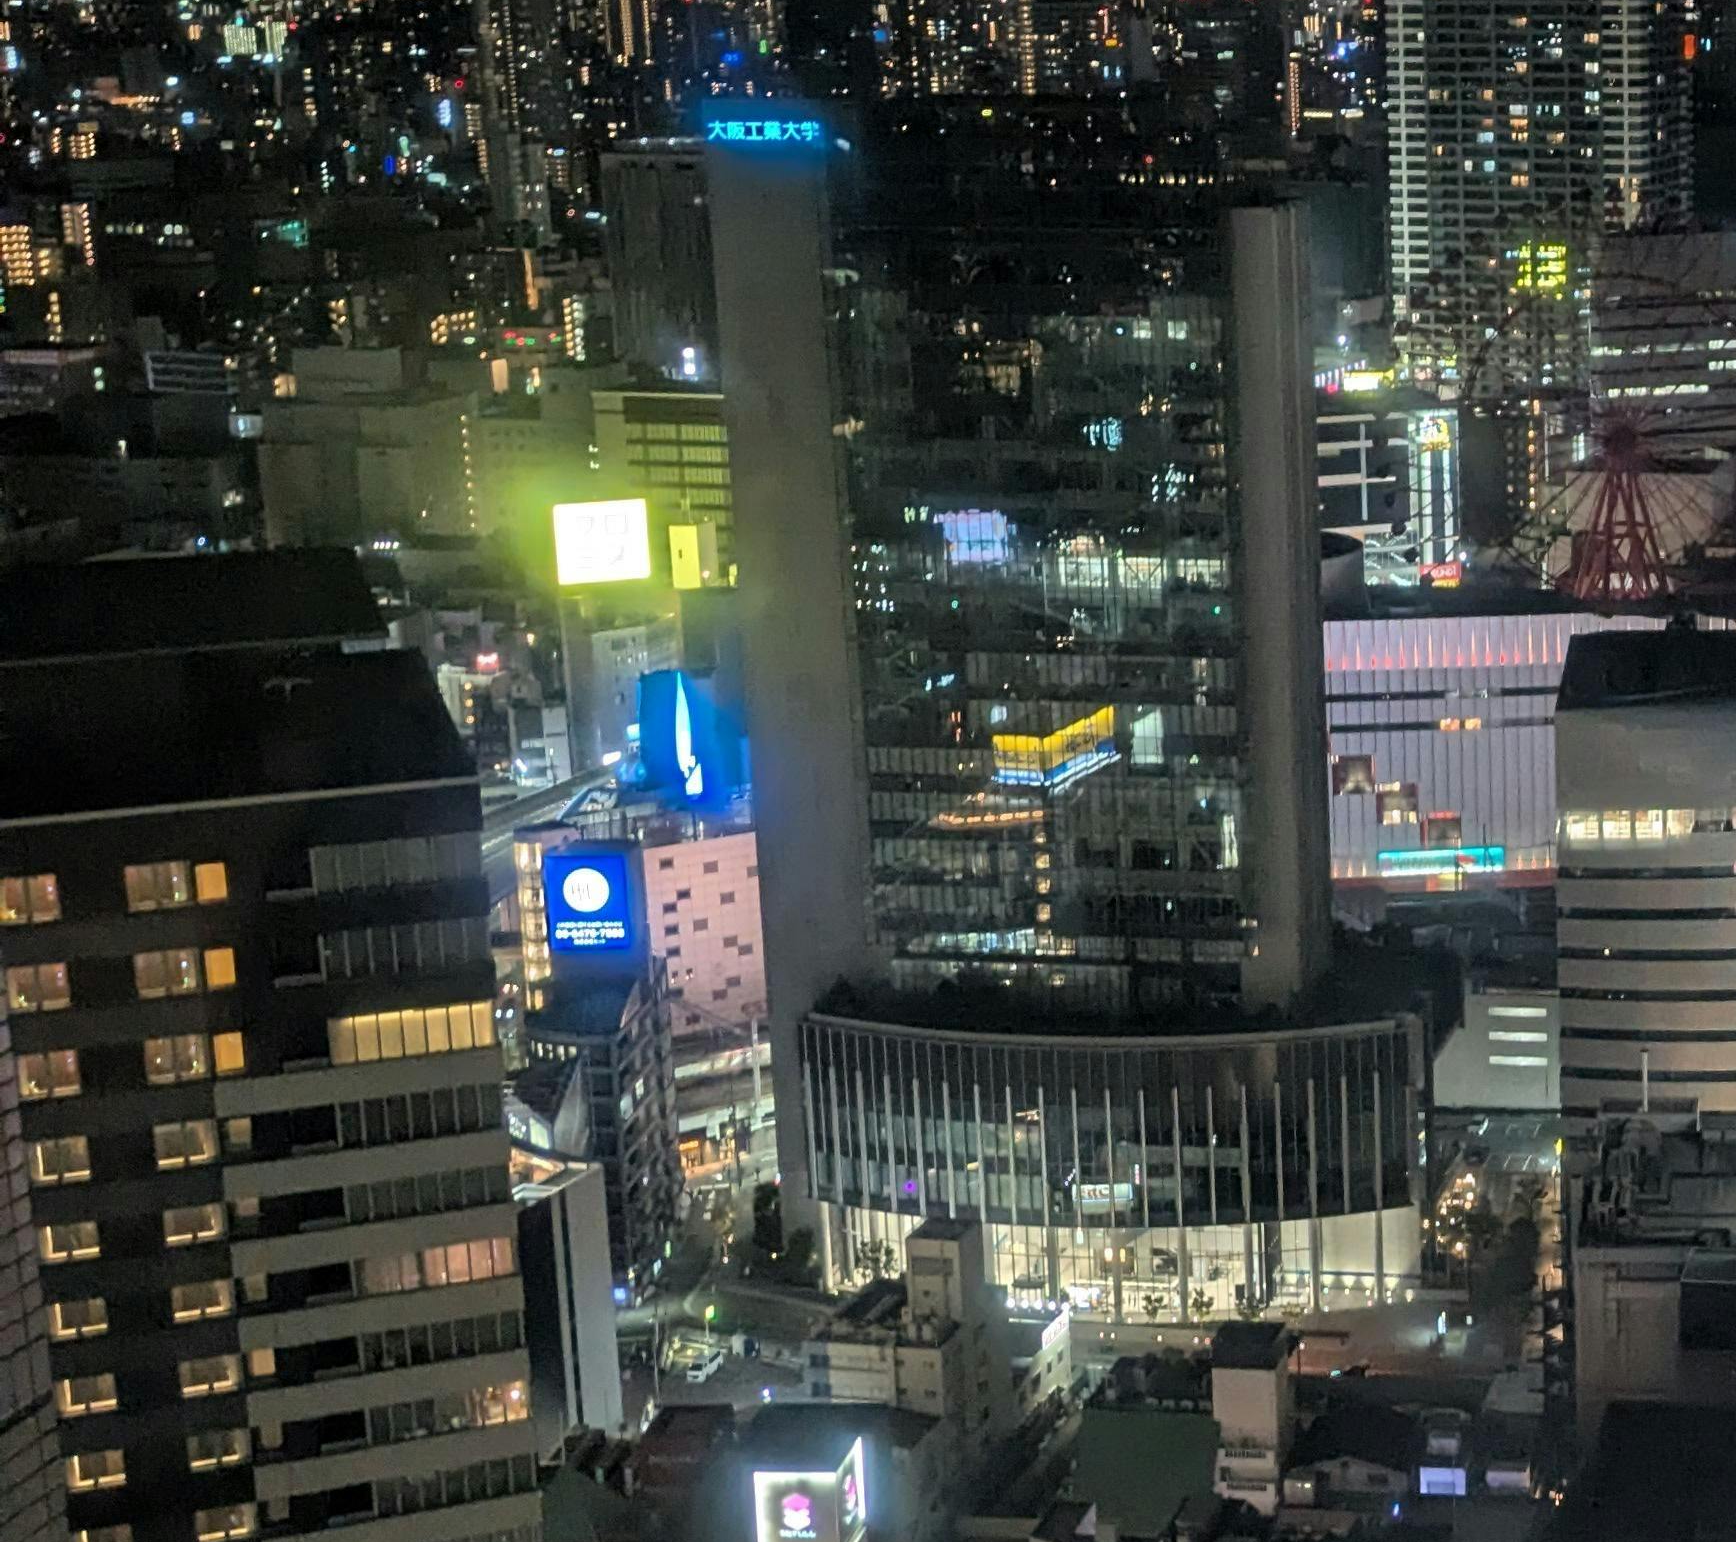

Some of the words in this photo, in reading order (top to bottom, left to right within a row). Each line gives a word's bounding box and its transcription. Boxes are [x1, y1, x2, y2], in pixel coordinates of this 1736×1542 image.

[707, 120, 820, 141] 大阪工業大学
